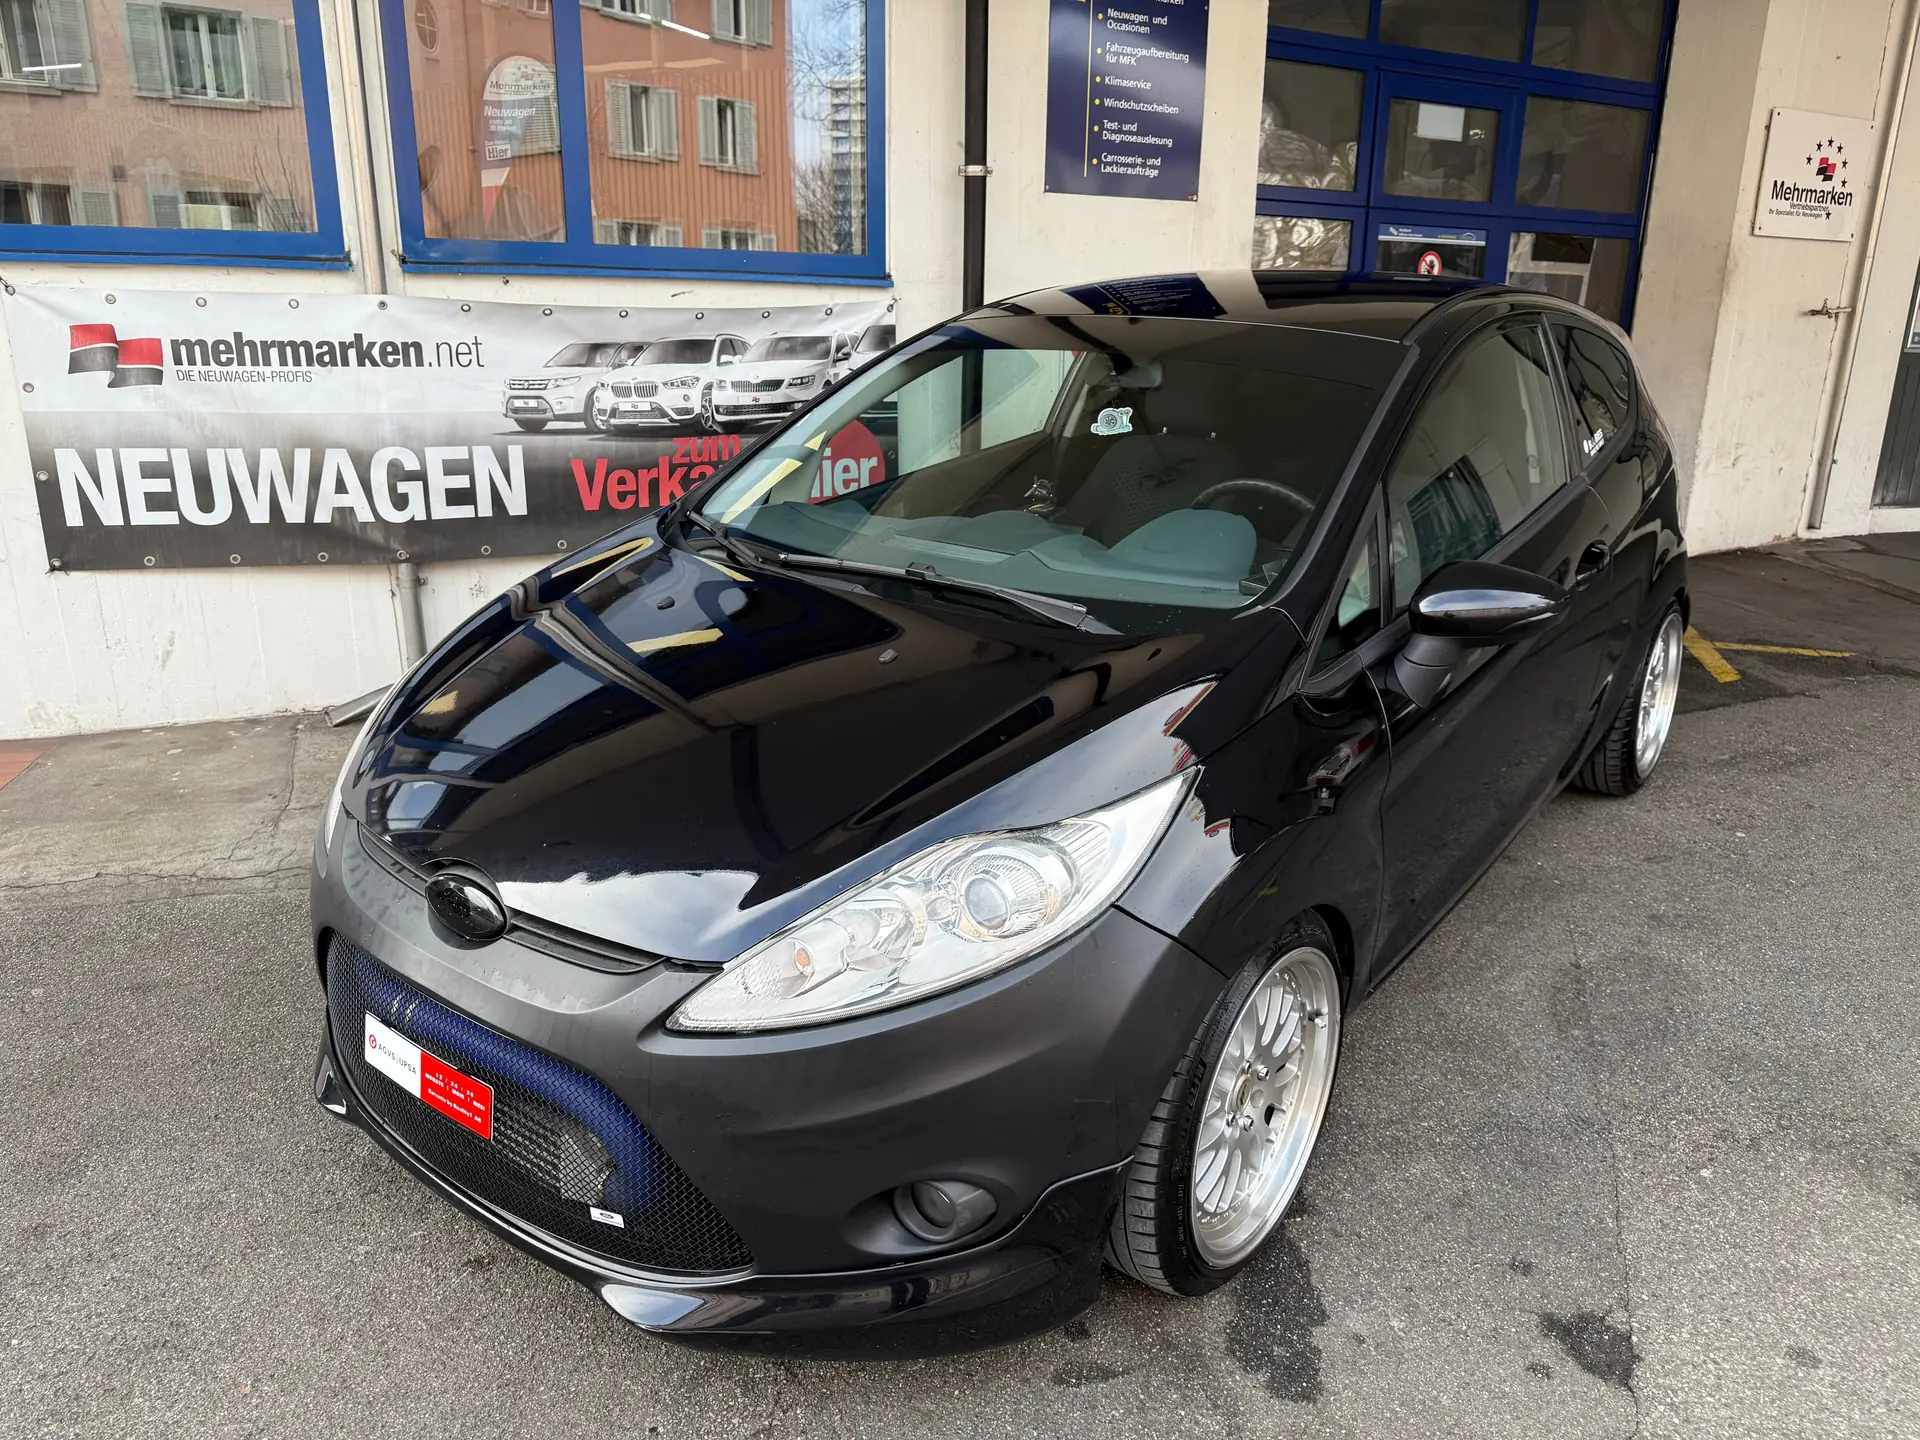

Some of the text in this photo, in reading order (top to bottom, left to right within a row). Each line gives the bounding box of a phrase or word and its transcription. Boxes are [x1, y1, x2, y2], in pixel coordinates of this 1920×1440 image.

[1107, 8, 1167, 25] Neuwagen und
[1107, 20, 1150, 34] Occasionen
[1106, 42, 1189, 63] Fahrzeugaufbereitung
[1106, 53, 1136, 65] für MFK
[489, 81, 550, 91] Mehrmarken
[1105, 76, 1151, 89] Klimaservice
[484, 105, 536, 118] Neuwagen
[1104, 98, 1179, 114] Windschutzscheiben
[1103, 120, 1137, 131] Test- und
[1102, 131, 1173, 147] Diagnoseauslesung
[487, 147, 509, 159] Hier
[1101, 152, 1161, 166] Carrosserie- und
[1101, 164, 1159, 178] Lackieraufträge
[1771, 180, 1853, 206] Mehrmarken
[1775, 208, 1795, 216] Spezialist
[1801, 211, 1822, 219] Neuwagen
[1789, 202, 1829, 212] Vertriebspartner
[170, 331, 485, 368] mehrmarken.net
[176, 370, 313, 383] DIE NEUWAGEN-PROFIS
[672, 434, 741, 464] zum
[53, 444, 528, 527] NEUWAGEN
[569, 447, 878, 511] Verka ier
